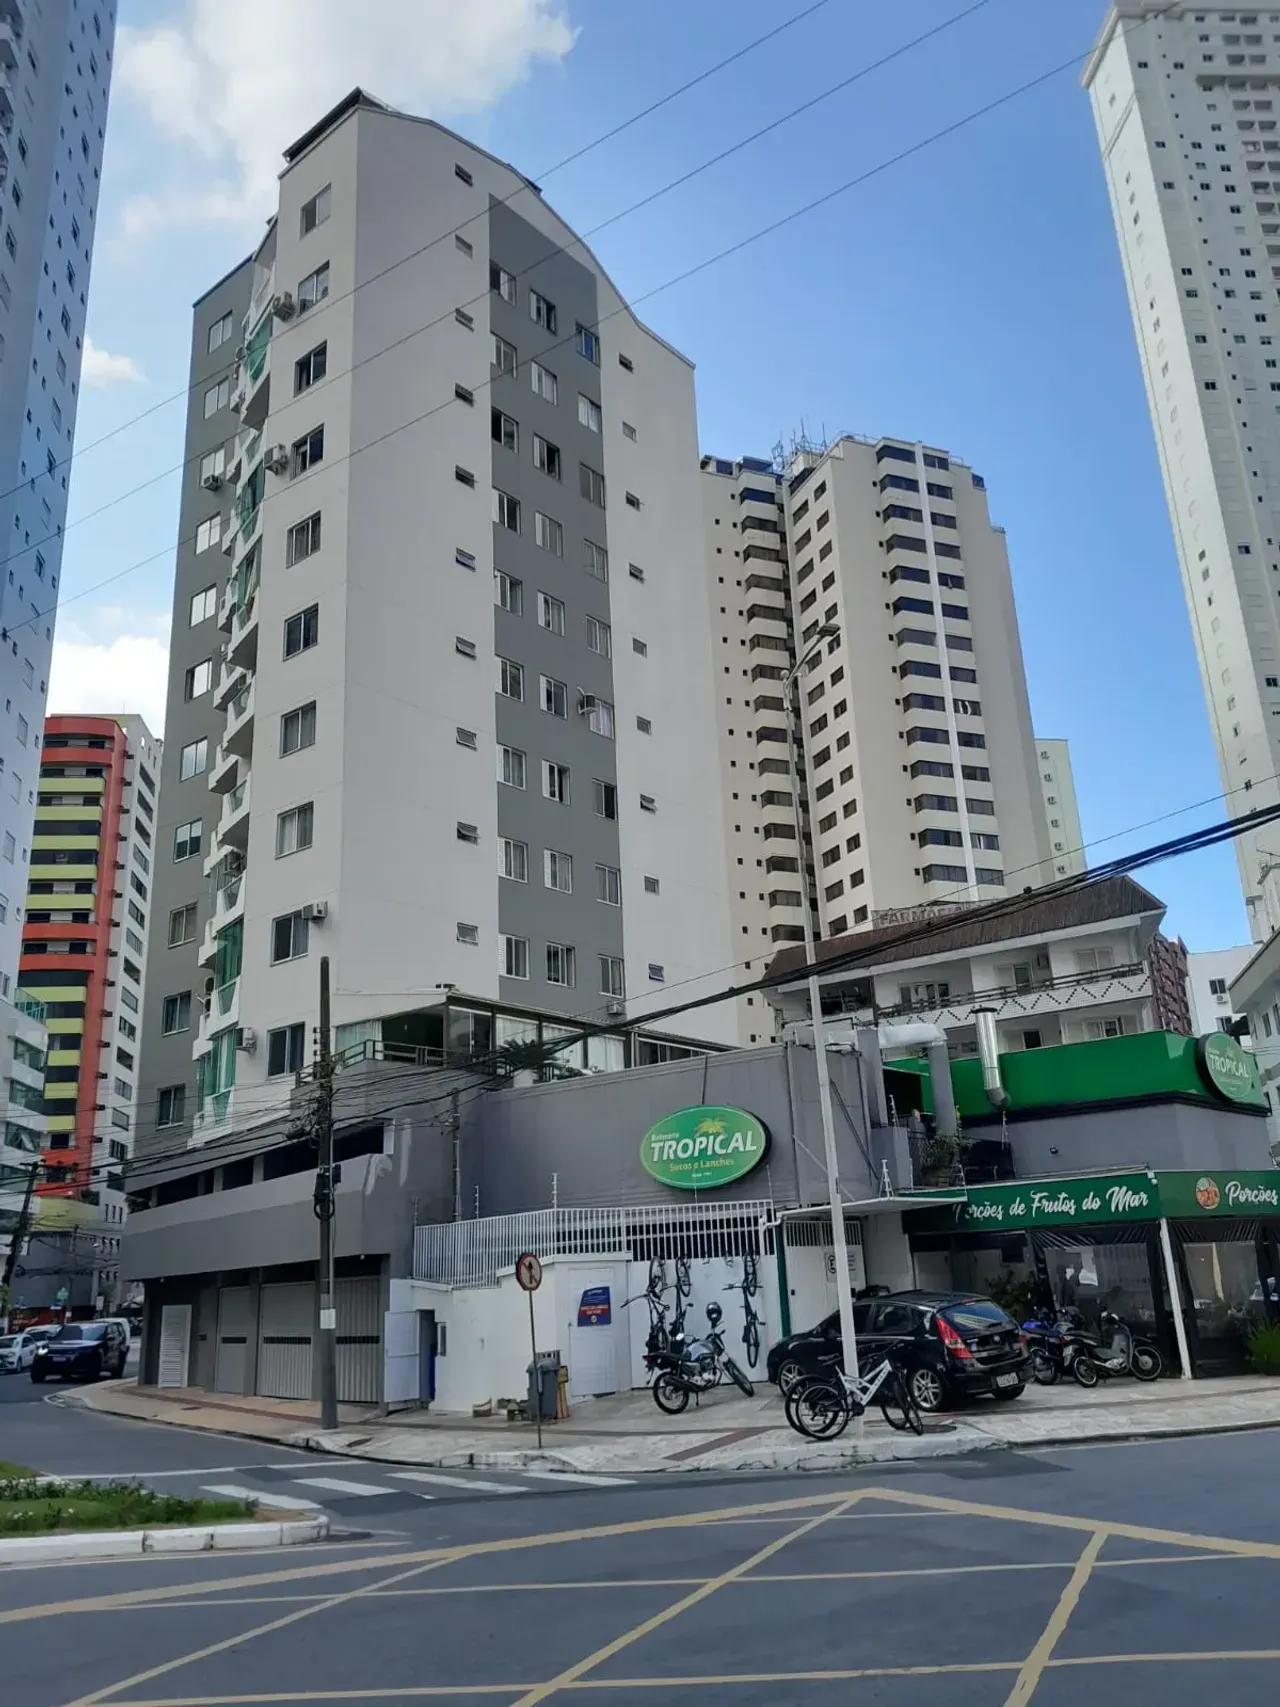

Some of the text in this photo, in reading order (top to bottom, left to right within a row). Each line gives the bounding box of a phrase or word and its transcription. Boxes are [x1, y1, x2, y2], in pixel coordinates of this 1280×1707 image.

[1209, 1054, 1249, 1078] TROPICAL
[650, 1130, 757, 1162] TROPICAL
[700, 1157, 734, 1168] Lanches
[1009, 1197, 1027, 1216] de
[1030, 1189, 1077, 1218] Frutos
[1082, 1191, 1101, 1210] do
[1106, 1185, 1149, 1213] Mar
[1225, 1180, 1279, 1207] Porções
